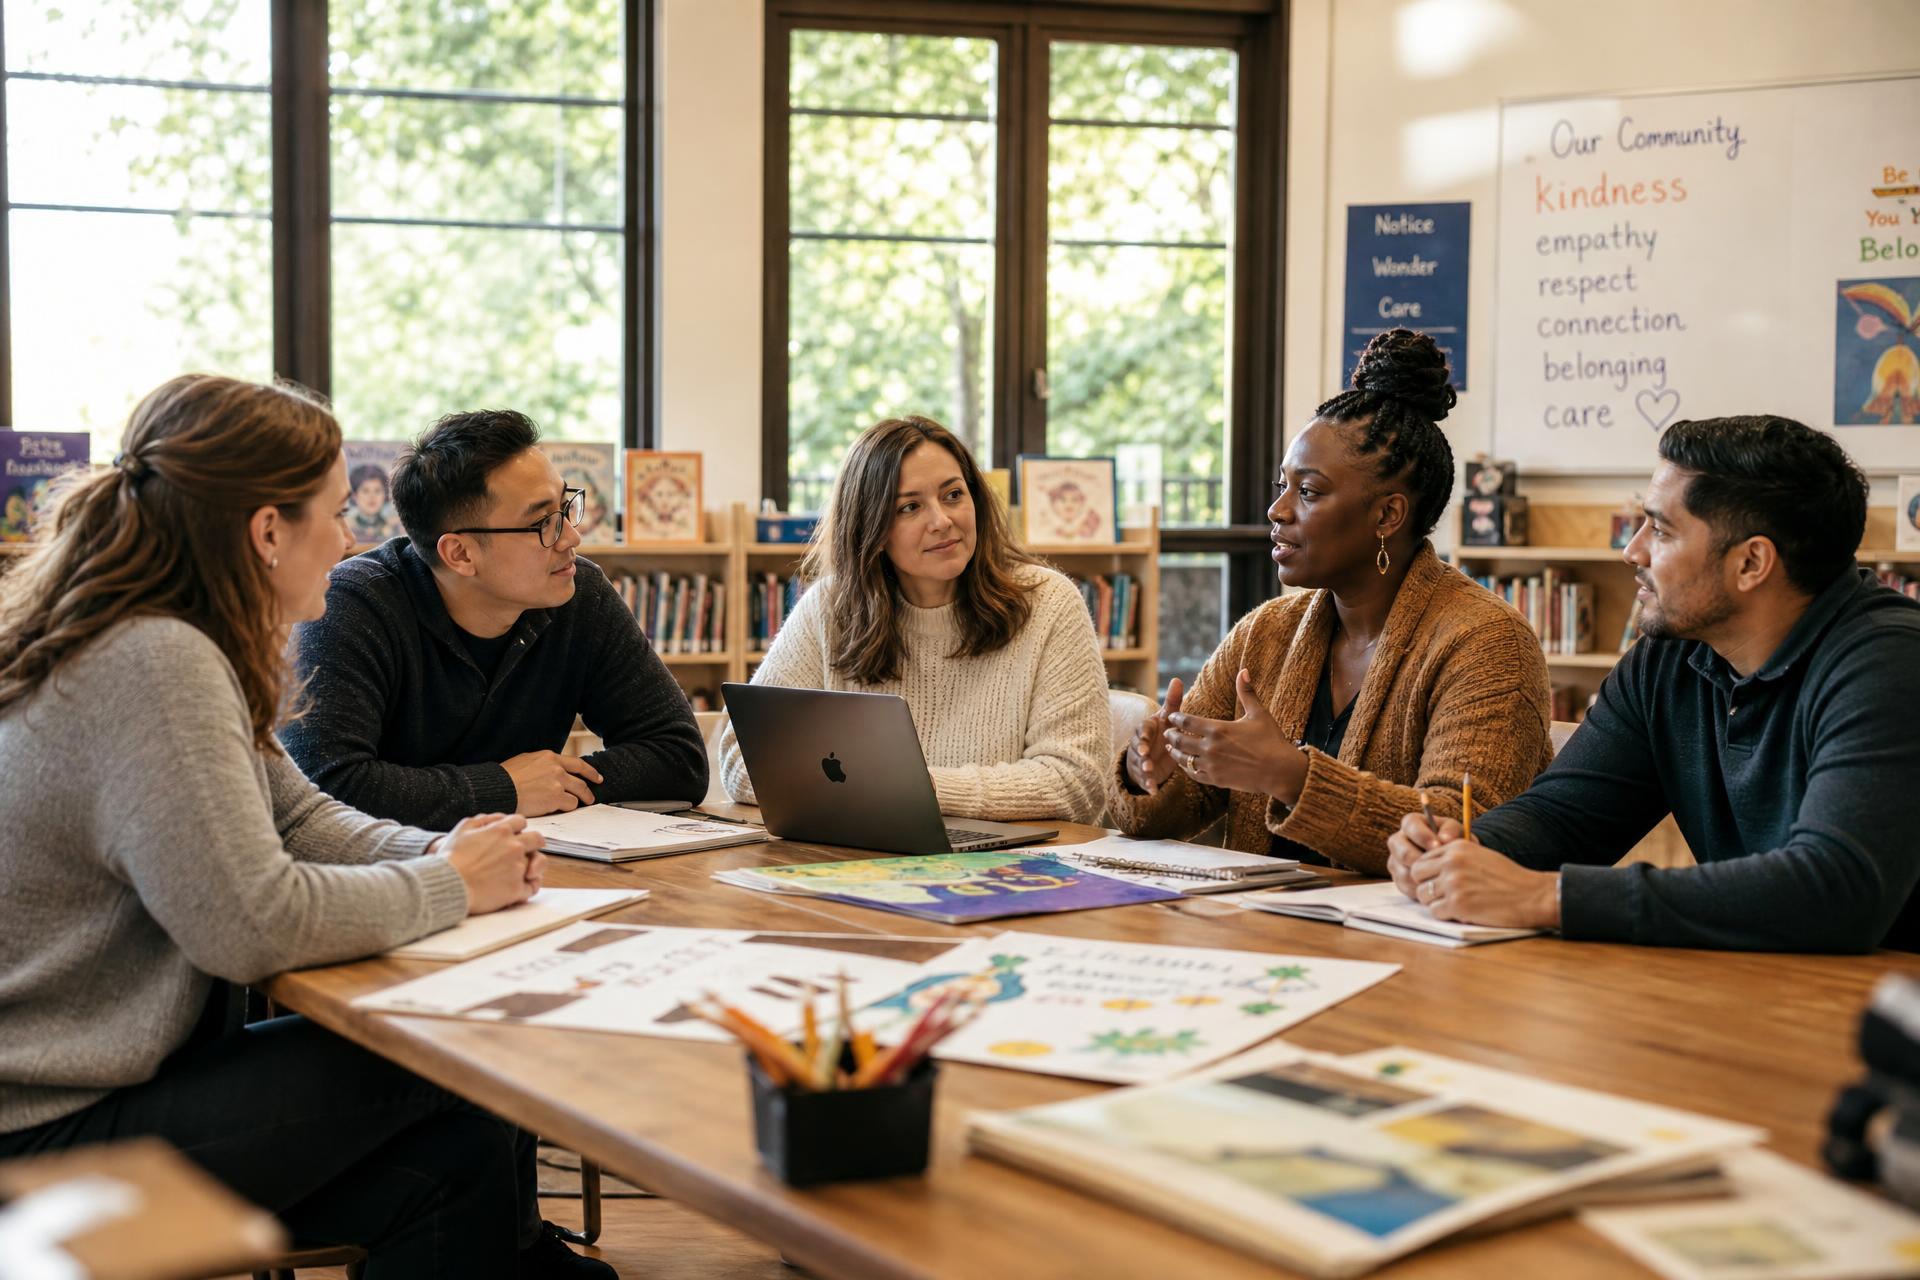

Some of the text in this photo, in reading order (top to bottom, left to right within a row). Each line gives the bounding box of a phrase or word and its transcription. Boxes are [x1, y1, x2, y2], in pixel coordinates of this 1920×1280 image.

[1550, 115, 1746, 160] Our Community
[1883, 166, 1908, 184] Be
[1535, 171, 1688, 214] kindness
[1374, 212, 1435, 236] Notice
[1865, 210, 1899, 227] You
[1536, 222, 1657, 262] empathy
[1860, 236, 1919, 262] Belo
[1372, 254, 1438, 277] Wonder
[1538, 266, 1637, 304] respect
[1378, 296, 1422, 318] Care
[1537, 305, 1687, 338] connection
[1544, 350, 1667, 391] belonging
[1544, 404, 1614, 428] care
